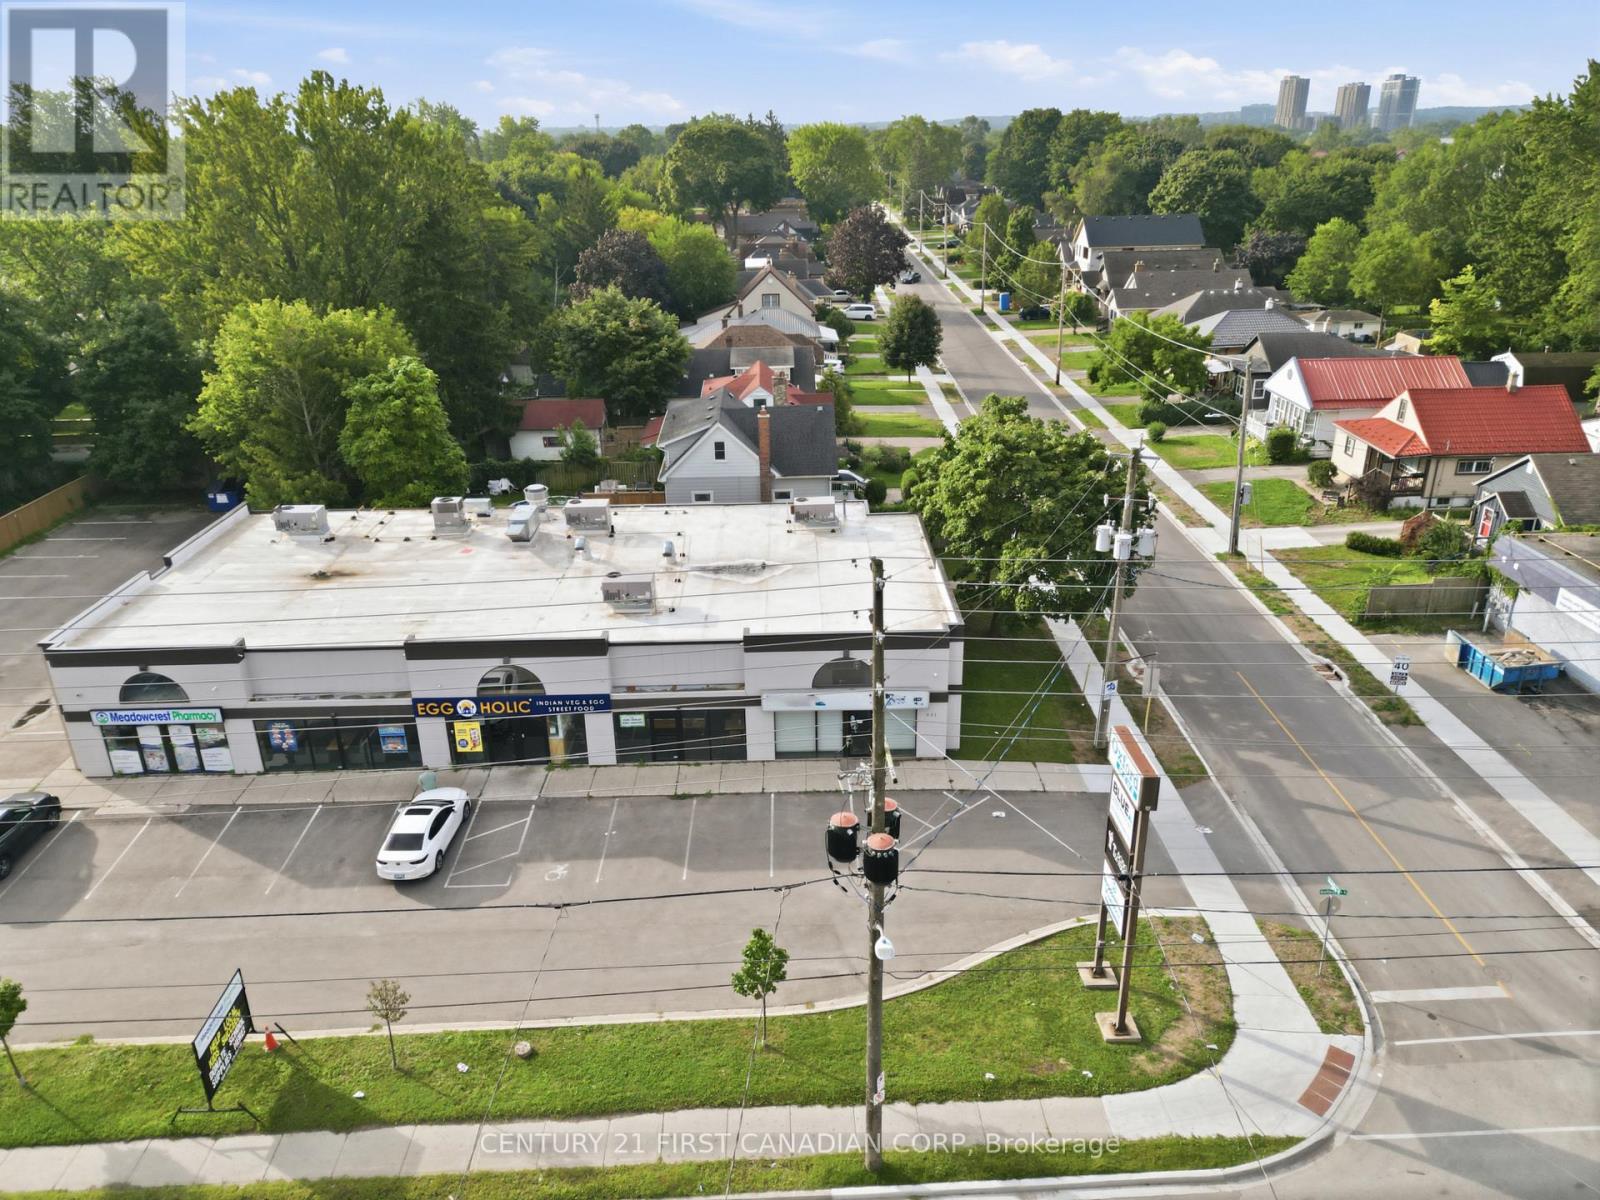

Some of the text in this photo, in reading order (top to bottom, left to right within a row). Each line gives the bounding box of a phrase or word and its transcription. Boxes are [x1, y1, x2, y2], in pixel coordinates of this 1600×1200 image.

[1394, 662, 1409, 670] 40
[417, 702, 454, 715] EGG
[480, 700, 531, 714] HOLIC
[109, 711, 217, 722] Meadowcrest Pharmacy
